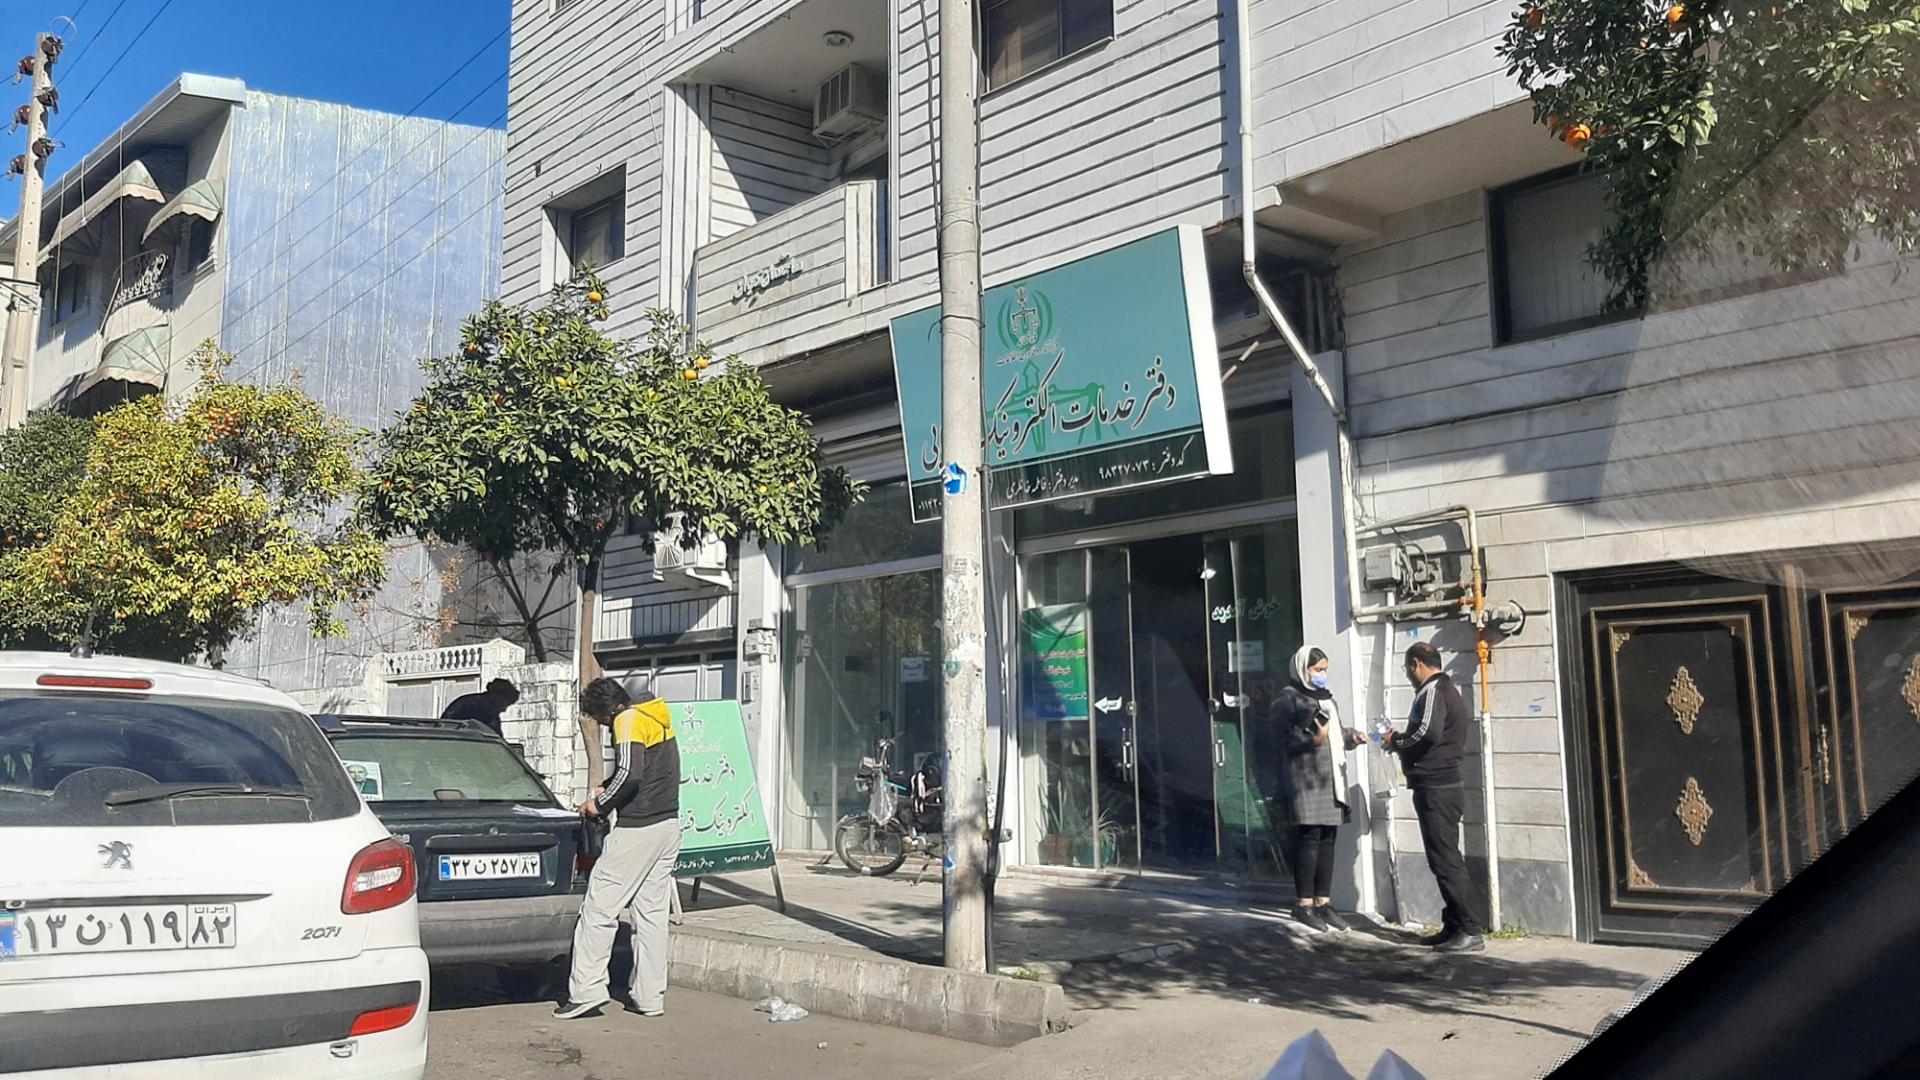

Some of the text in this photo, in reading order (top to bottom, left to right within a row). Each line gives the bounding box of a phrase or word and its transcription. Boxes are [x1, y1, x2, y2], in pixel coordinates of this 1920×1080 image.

[1060, 383, 1138, 434] خدمات
[1132, 356, 1177, 430] دفتر
[1176, 435, 1194, 467] کد
[712, 754, 736, 789] دفتر
[695, 783, 756, 838] الکترونیک
[194, 906, 229, 914] ایران
[191, 916, 231, 945] ۸۲
